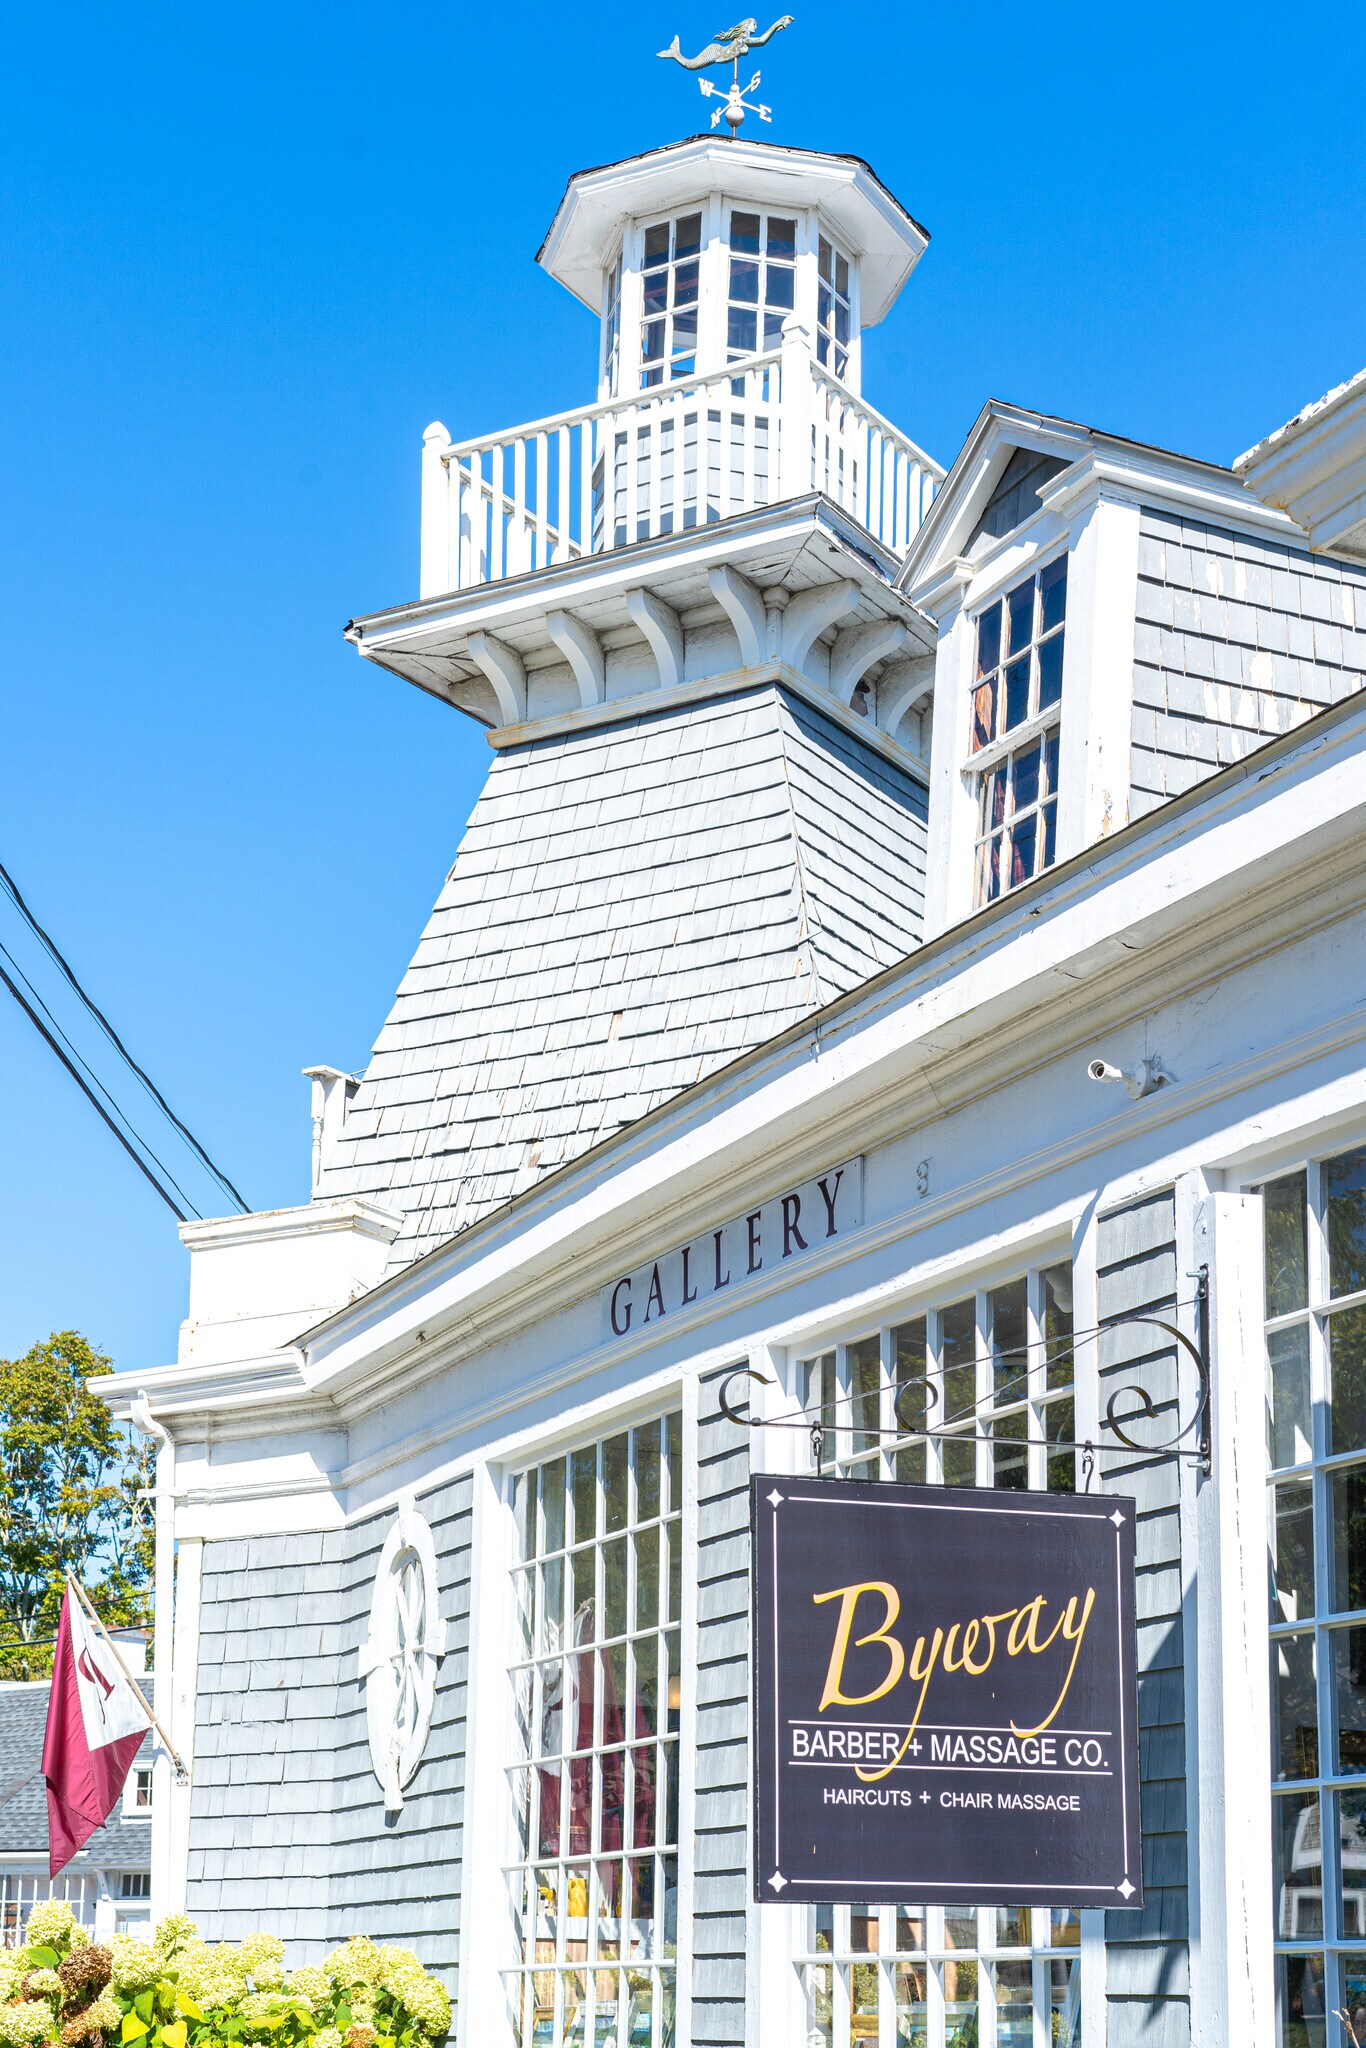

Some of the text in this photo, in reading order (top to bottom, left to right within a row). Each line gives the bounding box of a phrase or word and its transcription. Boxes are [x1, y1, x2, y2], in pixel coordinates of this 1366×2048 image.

[698, 77, 714, 97] W
[759, 104, 772, 123] E
[610, 1170, 845, 1336] GALLERY
[812, 1580, 1096, 1782] Byway
[792, 1728, 1109, 1767] BARBER + MASSAGE CO.
[823, 1788, 1081, 1812] HAIRCUTS + CHAIR MASSAGE
